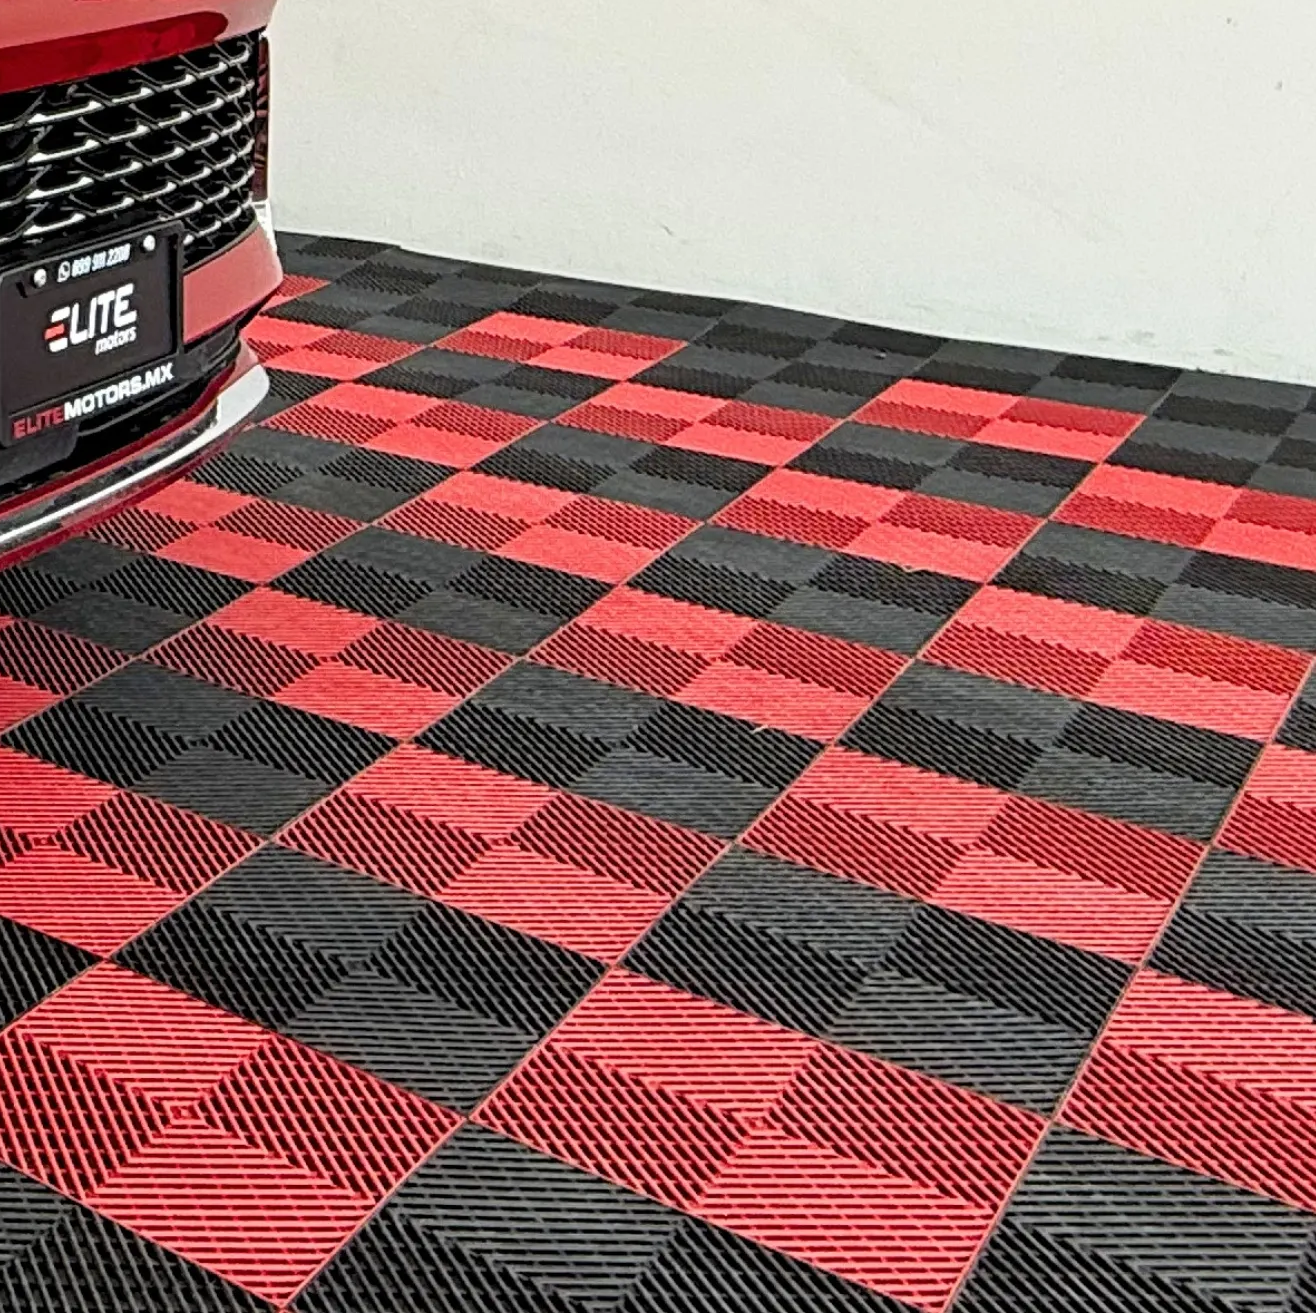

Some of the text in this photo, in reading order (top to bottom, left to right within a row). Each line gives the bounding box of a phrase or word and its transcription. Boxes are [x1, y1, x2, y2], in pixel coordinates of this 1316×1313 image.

[44, 283, 137, 353] ELITE
[95, 326, 137, 355] motors
[12, 362, 175, 439] ELITEMOTORS.MX
